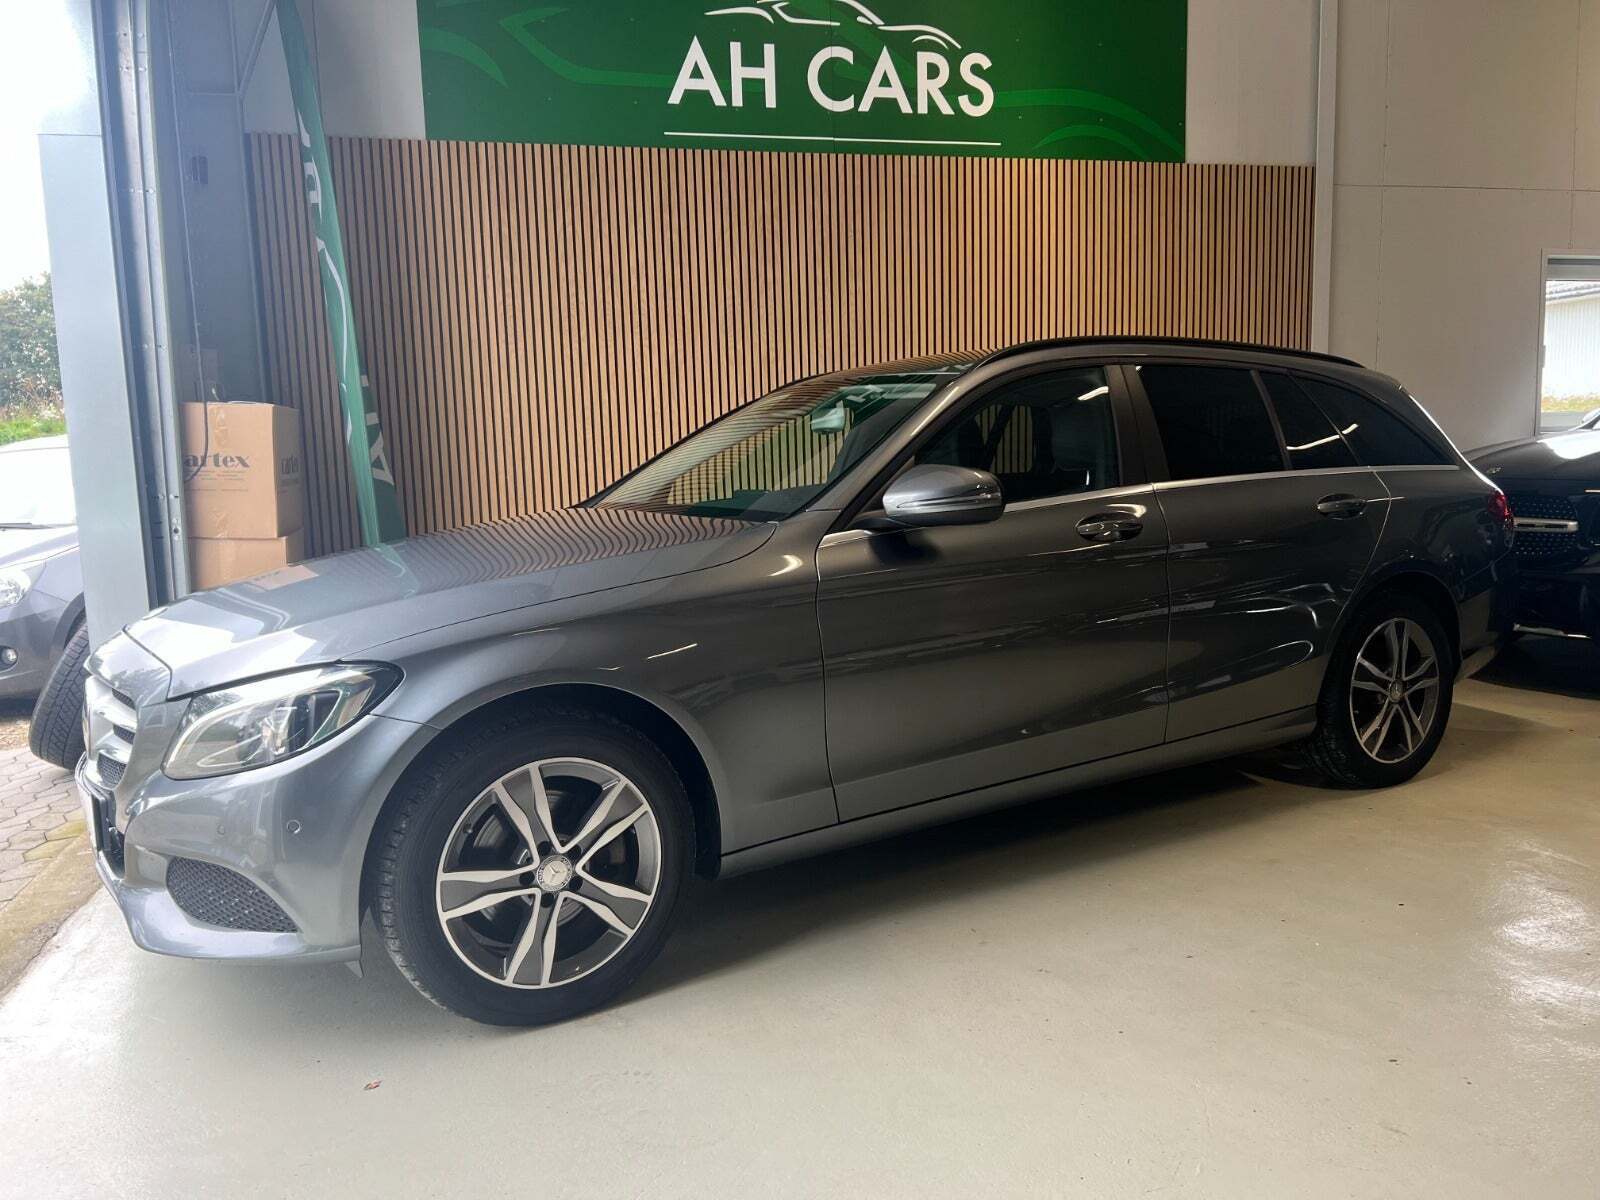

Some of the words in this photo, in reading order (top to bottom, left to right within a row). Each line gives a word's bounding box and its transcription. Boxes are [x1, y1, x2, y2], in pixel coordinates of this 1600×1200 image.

[667, 35, 777, 109] AH
[807, 45, 995, 118] CARS
[184, 453, 250, 468] artex
